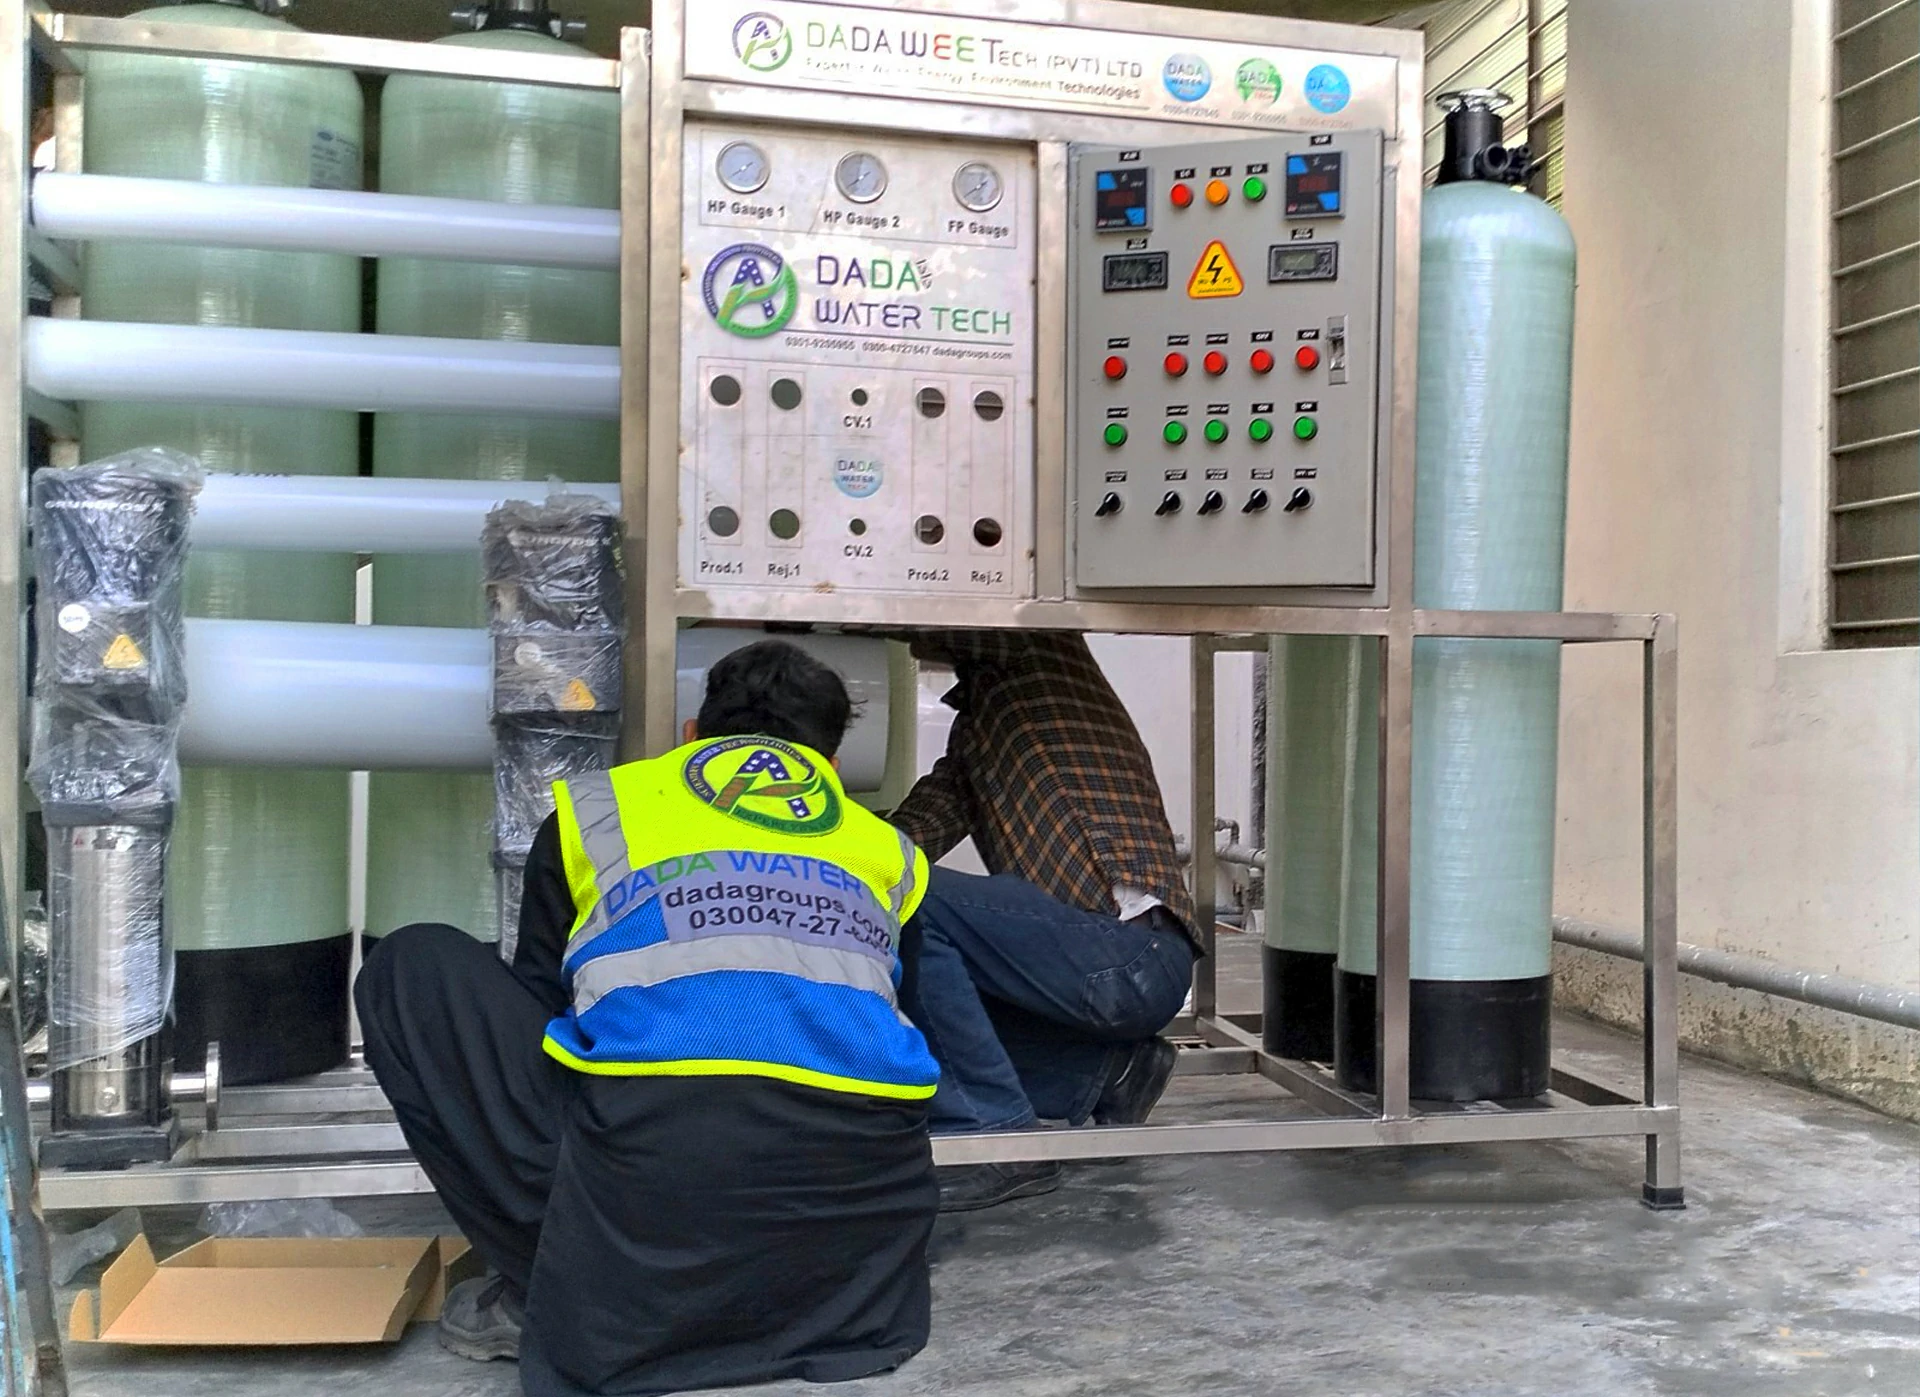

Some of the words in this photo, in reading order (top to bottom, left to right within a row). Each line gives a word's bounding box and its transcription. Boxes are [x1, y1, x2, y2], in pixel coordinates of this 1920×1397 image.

[807, 22, 892, 54] DADA
[901, 31, 975, 63] WEE
[1047, 54, 1100, 75] (PVT)
[1107, 60, 1143, 79] LTD
[1167, 62, 1203, 76] DADA
[1238, 70, 1277, 84] DADA
[1058, 81, 1141, 100] Technologies
[707, 200, 725, 213] HP
[731, 203, 774, 218] Gauge
[778, 206, 786, 218] 1
[823, 210, 842, 223] HP
[846, 213, 889, 229] Gauge
[891, 215, 900, 228] 2
[948, 220, 964, 234] FP
[969, 222, 1009, 238] Gauge
[816, 255, 919, 291] DADA
[816, 299, 922, 329] WATER
[930, 306, 1011, 335] TECH
[932, 345, 1013, 361] dadagroups.com
[843, 415, 872, 429] CV.1
[838, 459, 874, 472] DADA
[843, 545, 873, 558] CV.2
[700, 561, 743, 575] Prod.1
[768, 562, 801, 578] Rej.1
[907, 568, 949, 582] Prod.2
[971, 571, 1003, 586] Rej.2
[604, 855, 716, 918] DADA
[728, 850, 864, 900] WATER
[664, 881, 892, 948] dadagroups.com
